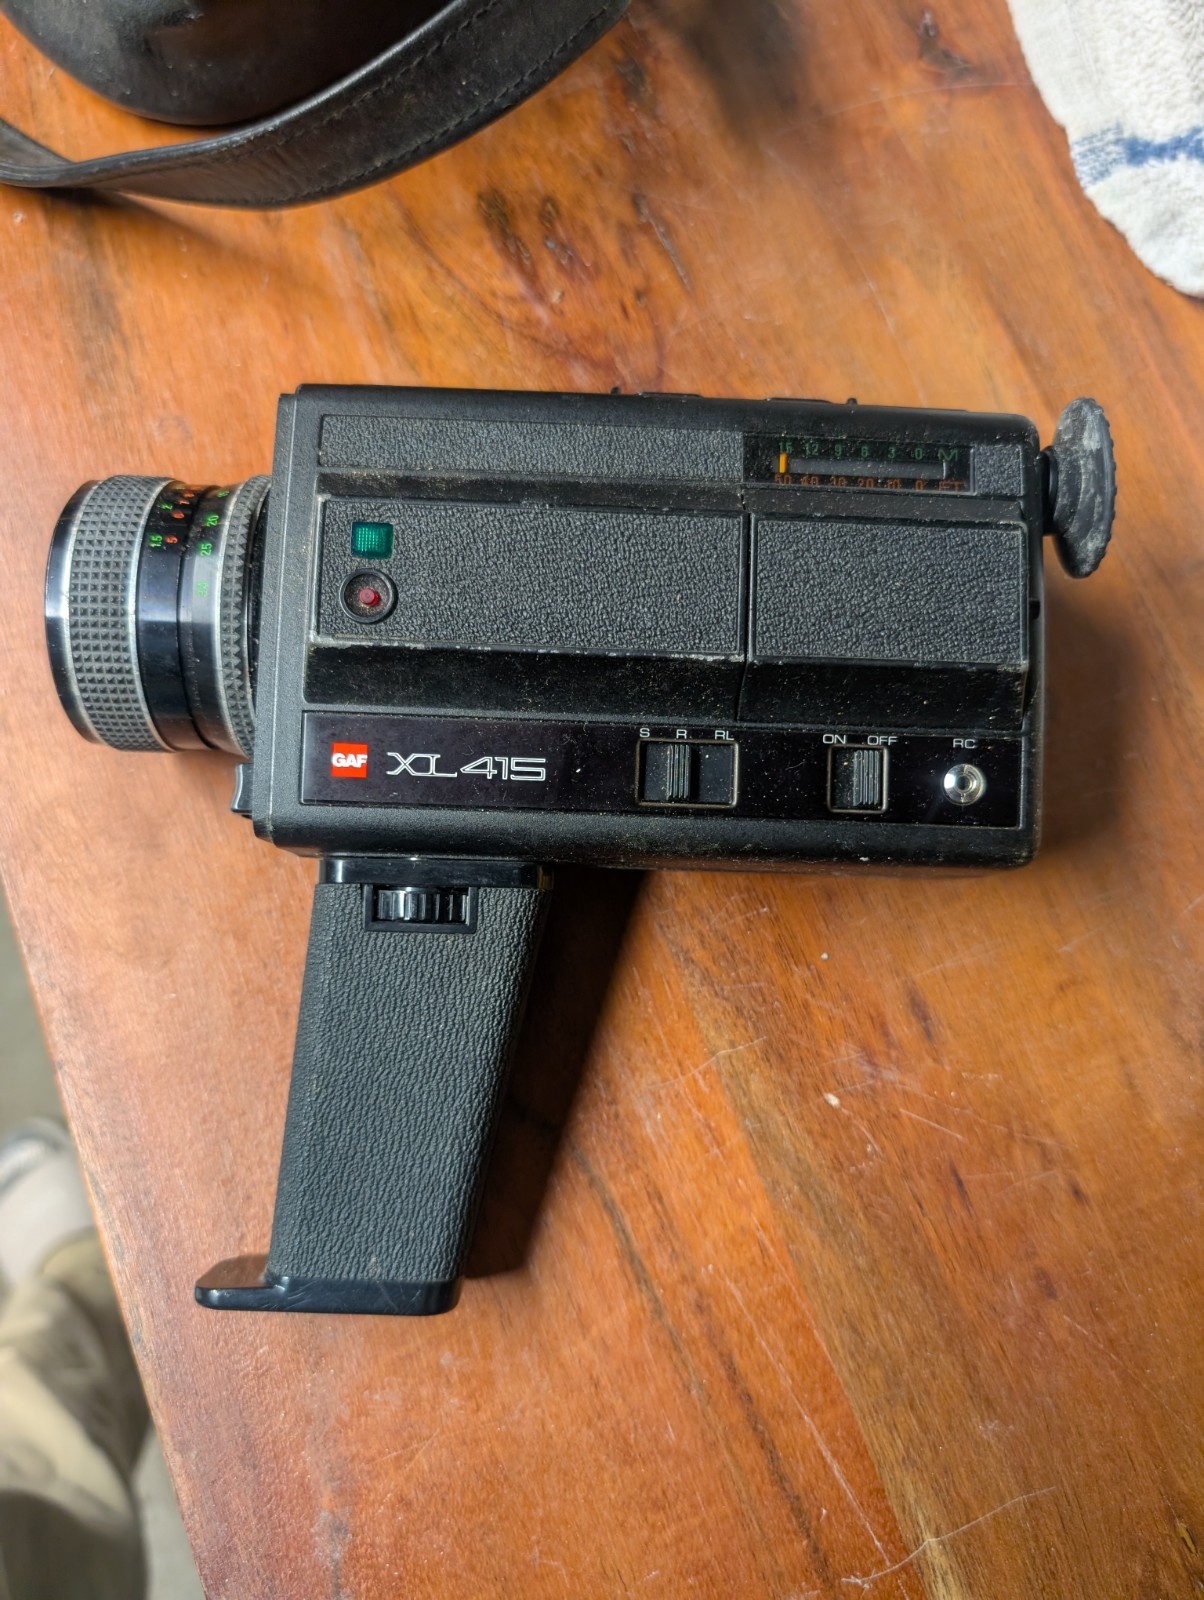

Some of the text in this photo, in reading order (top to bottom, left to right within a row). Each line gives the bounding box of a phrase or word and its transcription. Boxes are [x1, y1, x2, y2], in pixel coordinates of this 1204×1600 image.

[779, 441, 793, 454] 15
[805, 442, 819, 456] 12
[834, 443, 842, 457] 9
[888, 446, 896, 459] 3
[915, 447, 924, 460] 0
[938, 447, 959, 461] M
[914, 480, 924, 491] 0
[200, 542, 213, 556] 25
[639, 728, 734, 741] S R RL
[822, 733, 897, 746] ON OFF
[952, 738, 976, 749] RC
[331, 752, 368, 768] GAF
